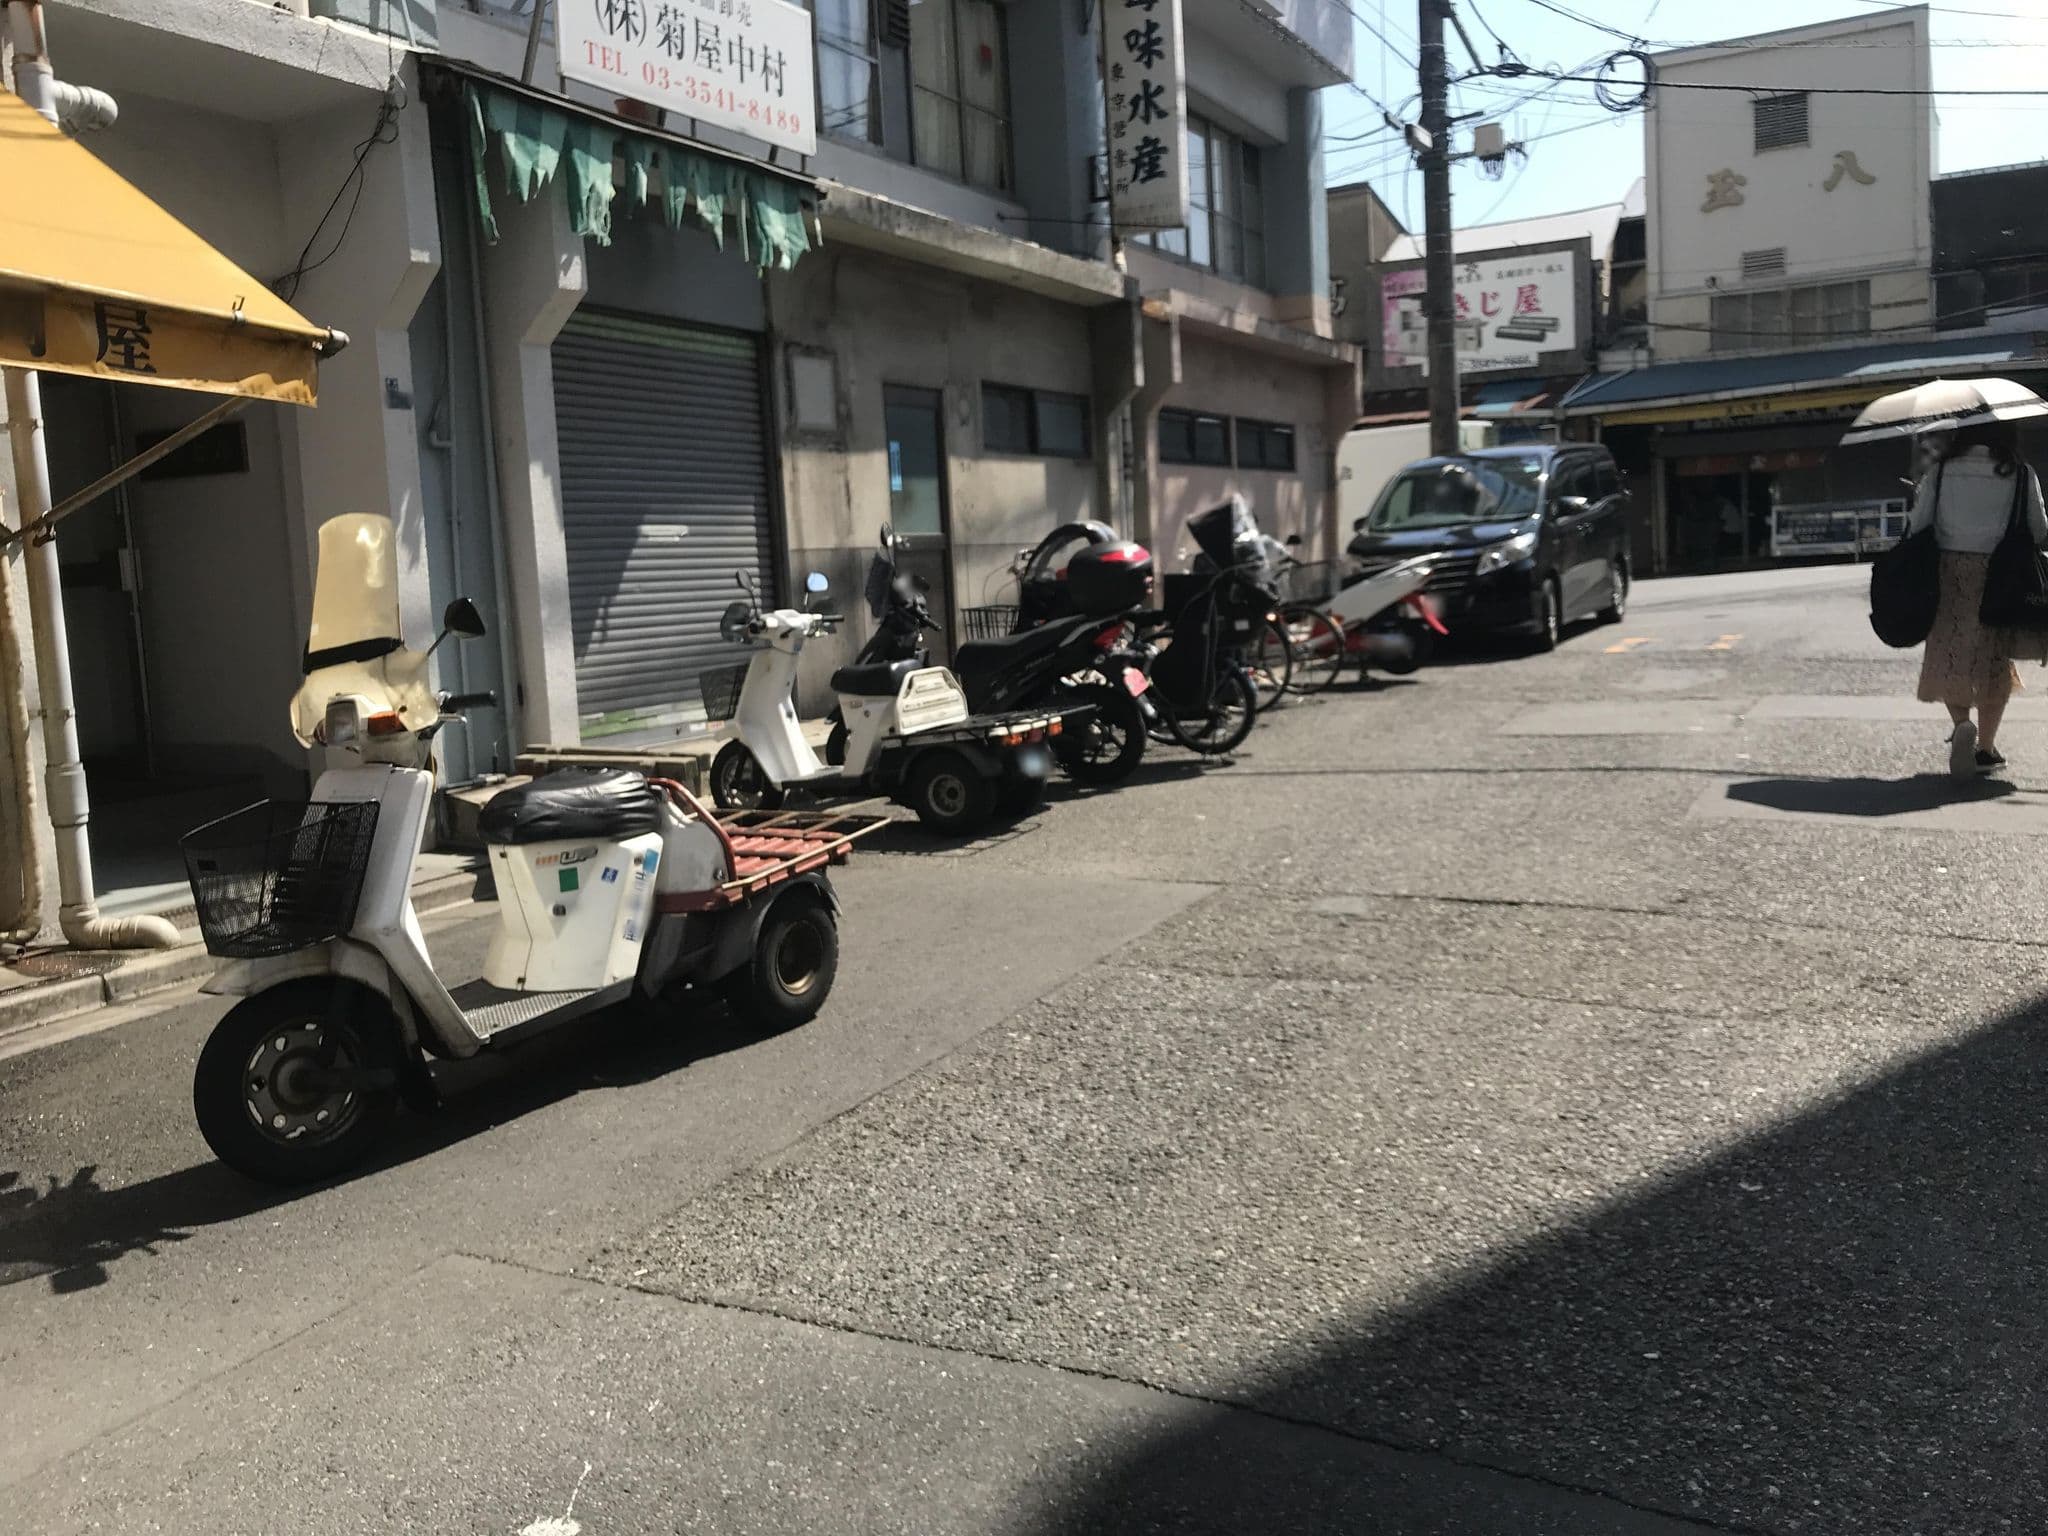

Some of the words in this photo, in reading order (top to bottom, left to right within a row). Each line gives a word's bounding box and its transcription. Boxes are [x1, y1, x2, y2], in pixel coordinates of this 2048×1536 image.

[584, 39, 629, 77] TEL
[1123, 0, 1169, 184] 味水産
